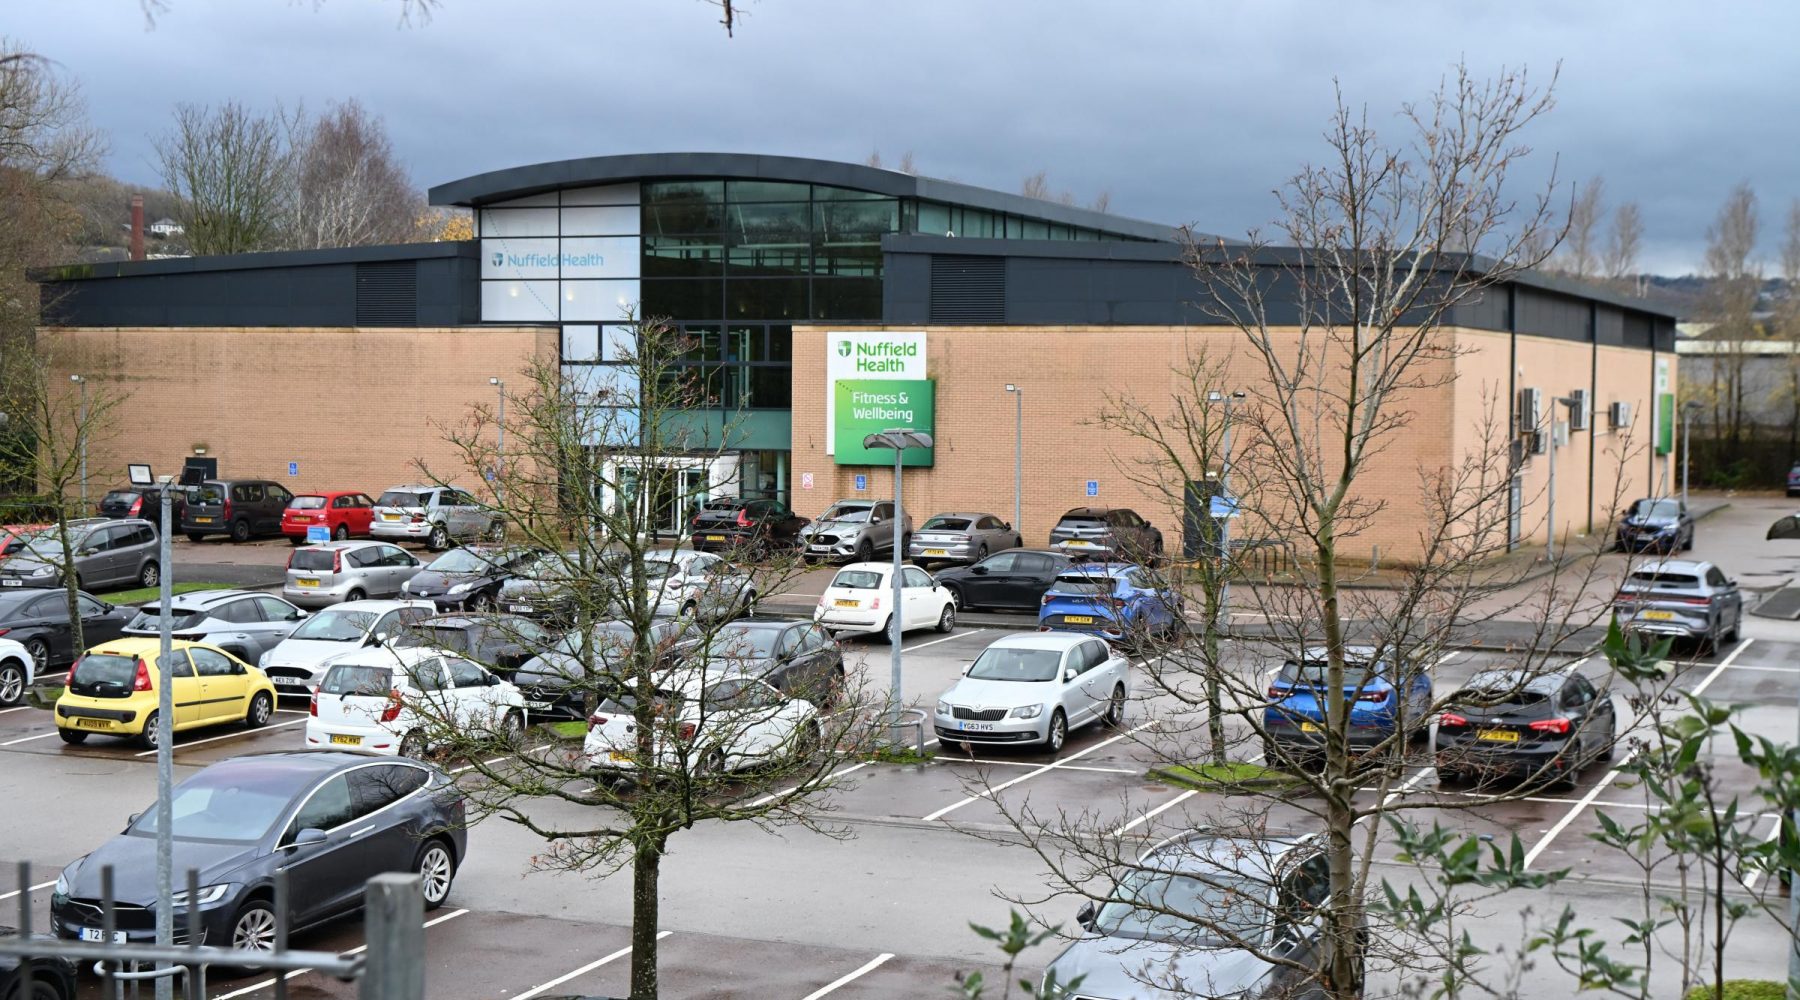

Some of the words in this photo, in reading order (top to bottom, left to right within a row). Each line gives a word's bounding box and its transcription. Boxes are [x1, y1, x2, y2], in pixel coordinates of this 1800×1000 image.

[508, 252, 560, 267] Nuffield
[562, 252, 604, 267] Health
[857, 342, 917, 357] Nuffield
[857, 358, 905, 372] Health
[853, 392, 896, 404] Fitness
[898, 392, 909, 405] &
[853, 407, 913, 423] Wellbeing
[963, 723, 980, 731] YG63
[980, 723, 994, 731] HVS
[332, 735, 348, 743] EY62
[89, 929, 99, 940] T2
